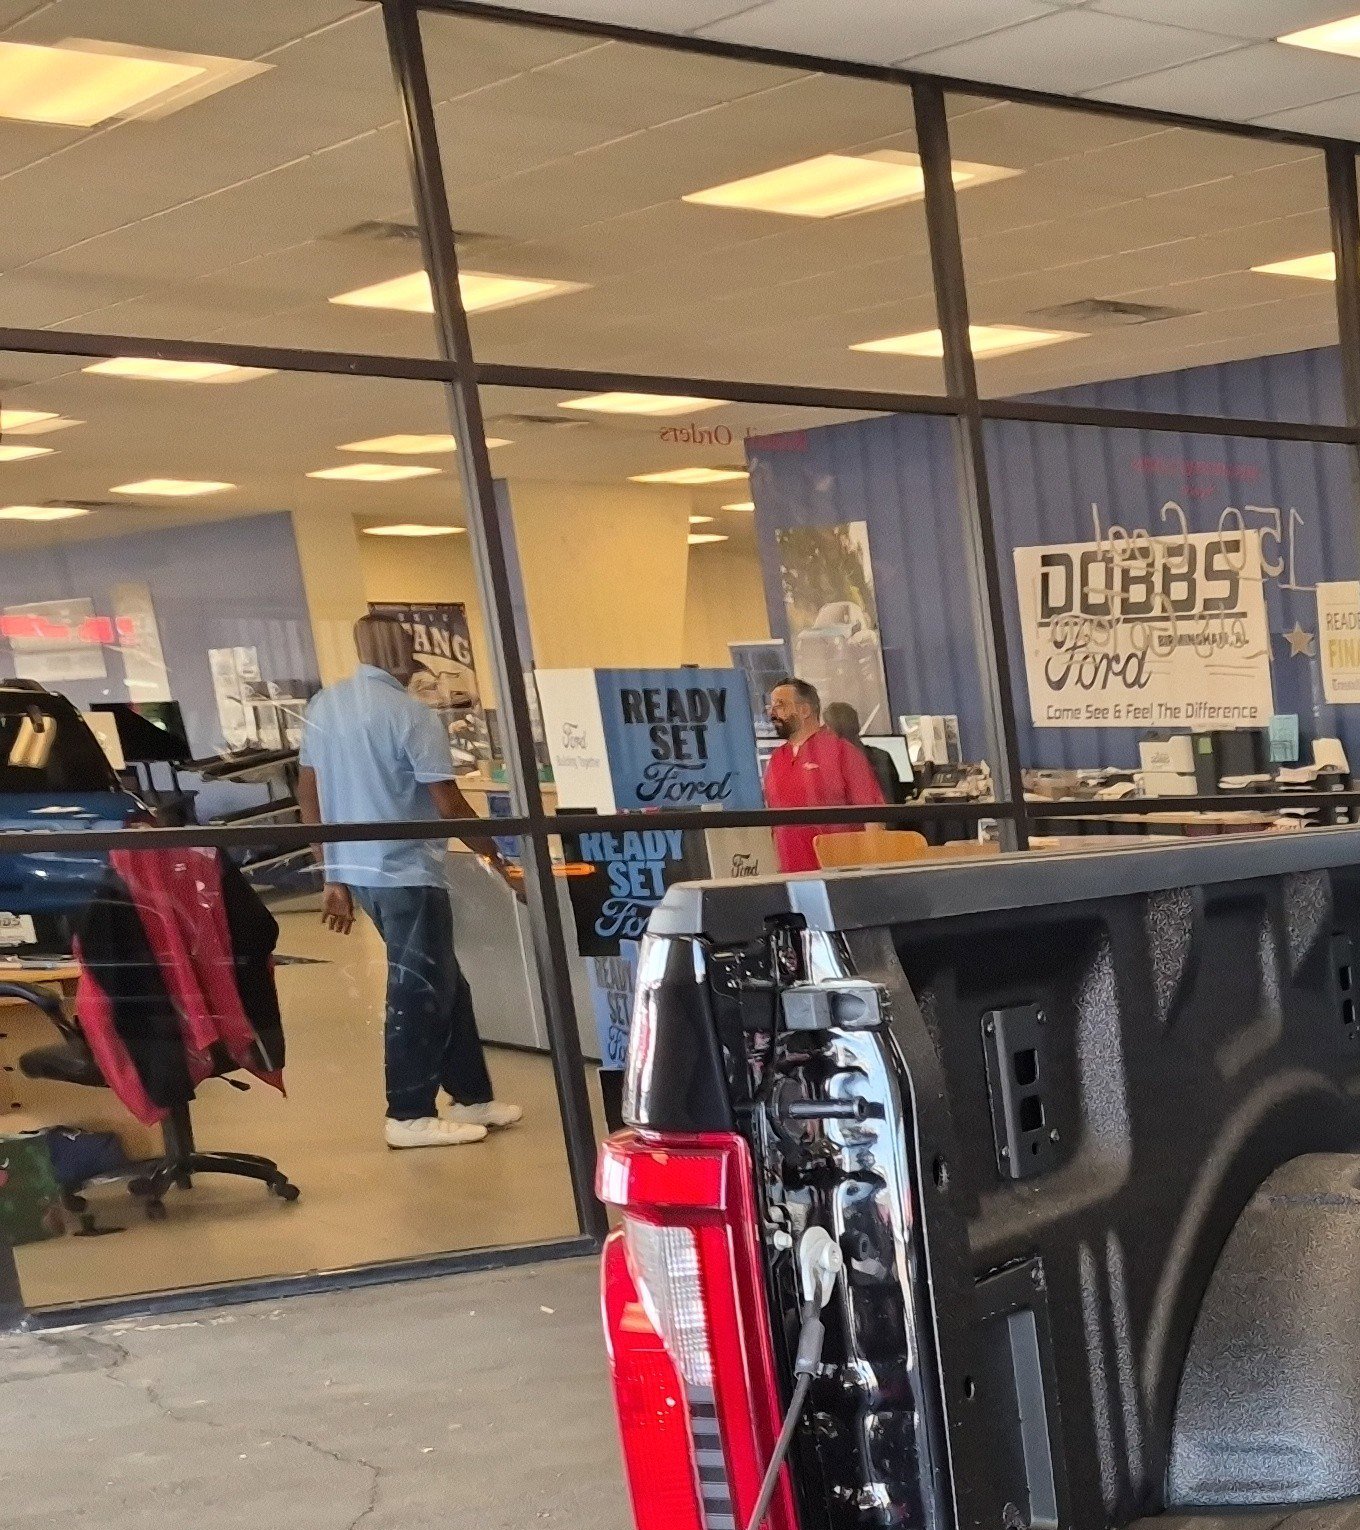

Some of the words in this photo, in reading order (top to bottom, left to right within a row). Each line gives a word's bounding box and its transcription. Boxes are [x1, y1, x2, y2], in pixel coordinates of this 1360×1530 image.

[1040, 539, 1243, 620] DOBBS
[1044, 612, 1152, 692] Ford
[620, 687, 727, 725] READY
[1046, 704, 1082, 720] Come
[1084, 703, 1110, 720] See
[1112, 704, 1122, 720] &
[1125, 702, 1154, 719] Feel
[1157, 702, 1182, 719] The
[1185, 701, 1258, 719] Difference
[650, 724, 709, 761] SET
[635, 761, 733, 802] Ford
[607, 860, 667, 898] SET
